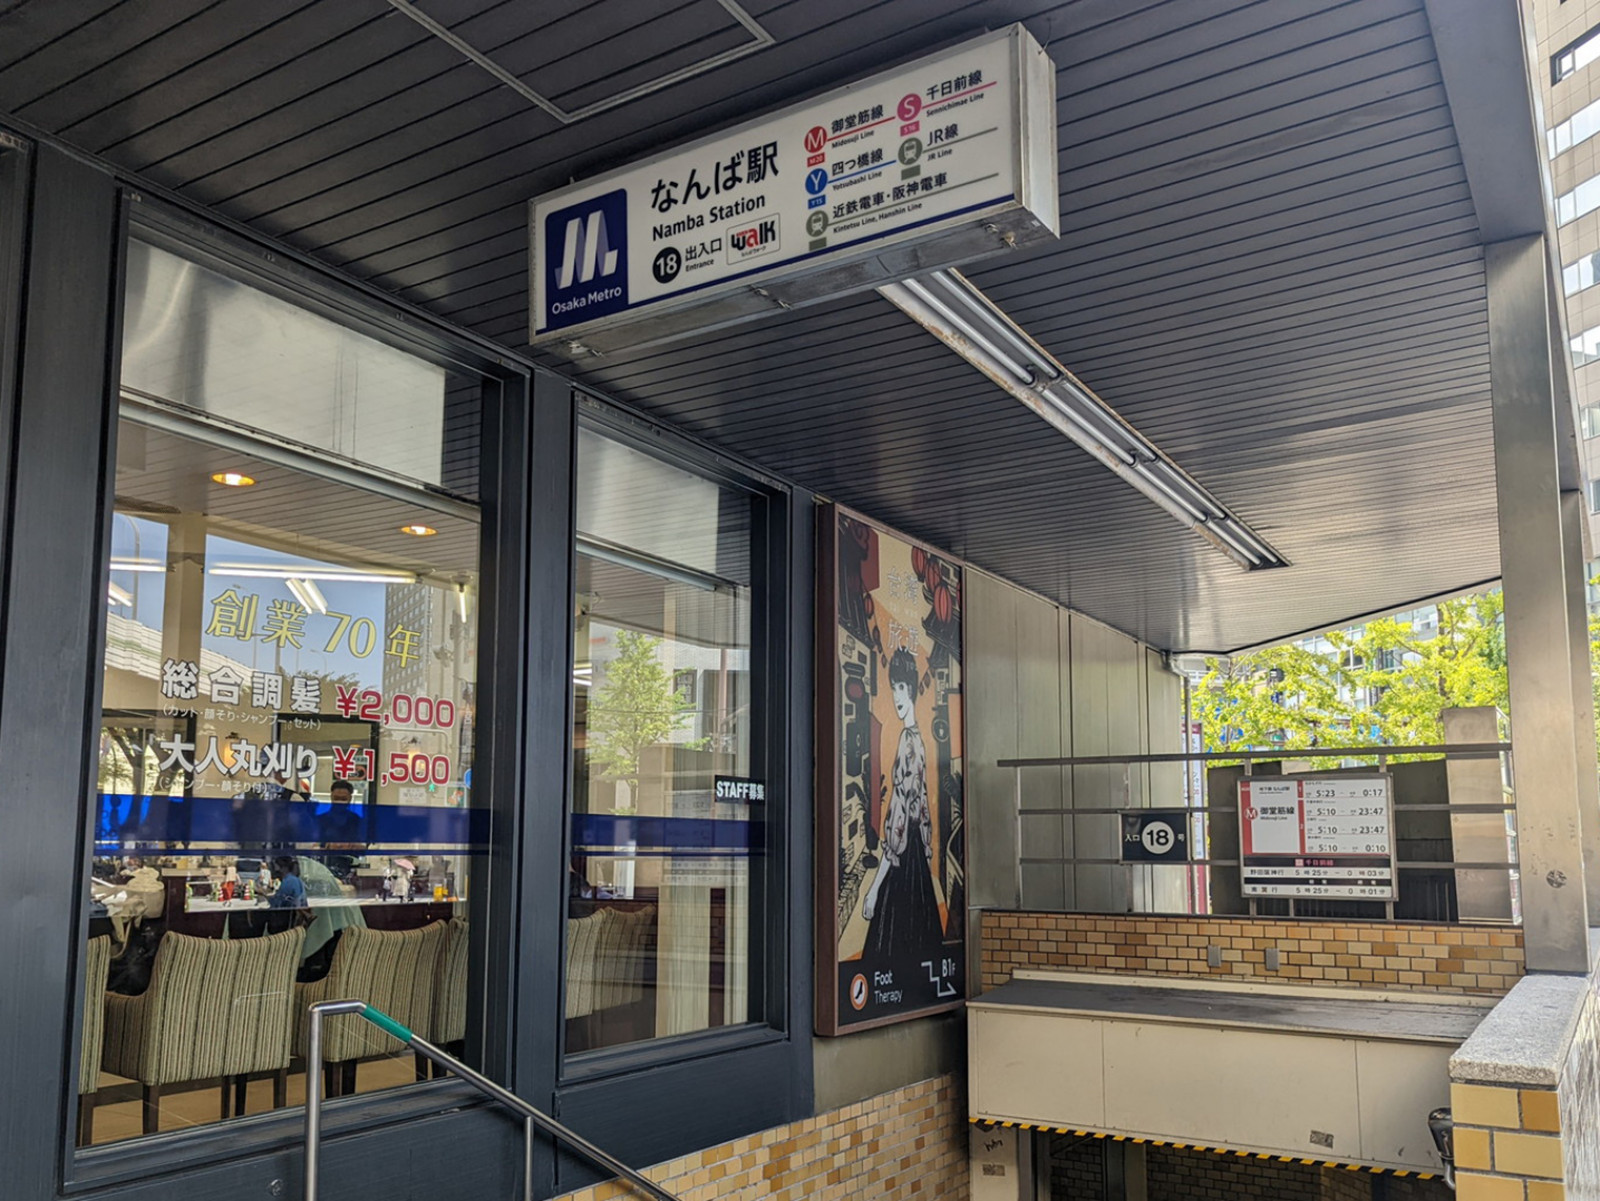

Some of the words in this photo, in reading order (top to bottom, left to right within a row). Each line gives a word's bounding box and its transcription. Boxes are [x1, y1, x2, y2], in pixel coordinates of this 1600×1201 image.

[926, 70, 983, 101] 千日前線
[903, 96, 915, 118] S
[926, 98, 968, 117] Sennichimae
[969, 92, 984, 104] Line
[831, 104, 884, 134] 御堂筋線
[807, 128, 825, 151] M
[831, 133, 859, 149] Midosuji
[860, 129, 875, 140] Line
[927, 123, 959, 146] JR線
[831, 148, 884, 176] 四つ橋線
[927, 152, 937, 162] JR
[937, 148, 952, 159] Line
[651, 141, 779, 213] なんば駅
[810, 170, 823, 191] Y
[832, 175, 867, 192] Yotsubashi
[867, 170, 882, 181] Line
[653, 214, 705, 242] Namba
[709, 195, 766, 224] Station
[833, 219, 862, 234] Kintetsu
[878, 206, 906, 220] Hanshin
[907, 201, 922, 213] Line
[685, 238, 722, 261] 出入口
[656, 253, 678, 277] 18
[685, 259, 715, 272] Entrance
[552, 298, 587, 315] Osaka
[587, 286, 622, 304] Metro
[161, 658, 322, 714] 総合調髪
[335, 684, 455, 729] ¥2,000
[159, 733, 318, 779] 大人丸刈り
[332, 745, 451, 787] ¥1,500
[1316, 789, 1336, 798] 5:23
[1362, 788, 1383, 797] 0:17
[1246, 808, 1257, 820] M
[1260, 806, 1295, 815] 御堂筋線
[1317, 807, 1337, 816] 5:10
[1358, 807, 1384, 816] 23:47
[1125, 833, 1140, 842] 入口
[1146, 829, 1169, 847] 18
[1318, 826, 1338, 834] 5:10
[1360, 826, 1385, 834] 23:47
[1319, 844, 1338, 852] 5:10
[1365, 844, 1386, 853] 0:10
[874, 969, 893, 987] Foot
[874, 989, 903, 1005] Therapy
